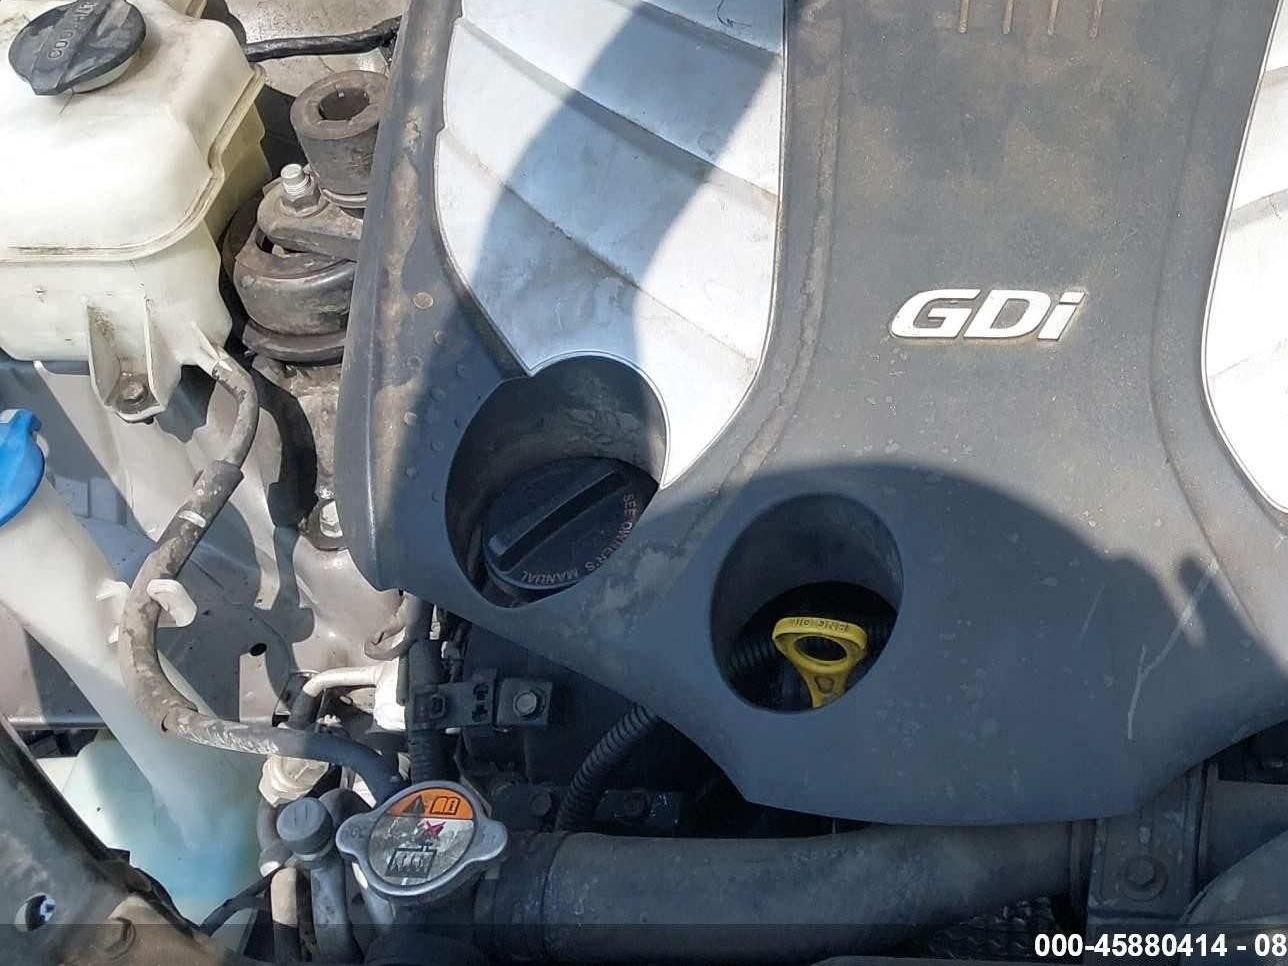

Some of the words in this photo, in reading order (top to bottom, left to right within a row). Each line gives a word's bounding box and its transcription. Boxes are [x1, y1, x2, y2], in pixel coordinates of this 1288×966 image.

[890, 289, 1085, 341] GDi
[623, 494, 638, 518] SEE
[521, 569, 580, 584] MANUAL
